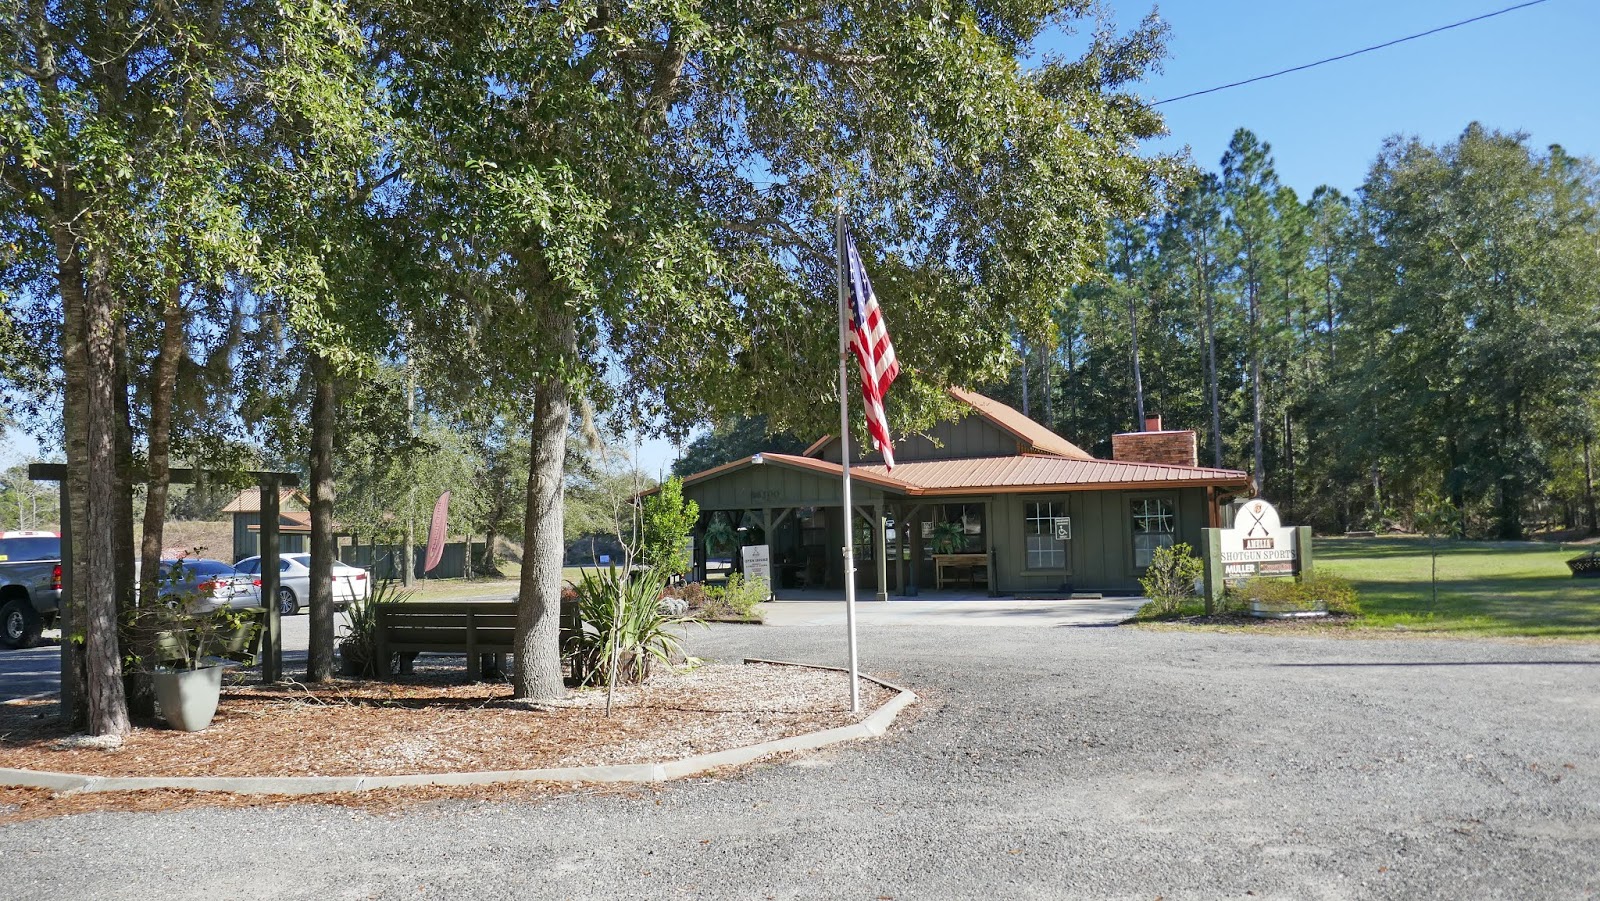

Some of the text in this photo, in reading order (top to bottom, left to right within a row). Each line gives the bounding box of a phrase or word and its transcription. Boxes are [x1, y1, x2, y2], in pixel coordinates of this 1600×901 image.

[1220, 549, 1296, 561] SHOTGUN SPORTS
[1225, 564, 1255, 573] MULLER
